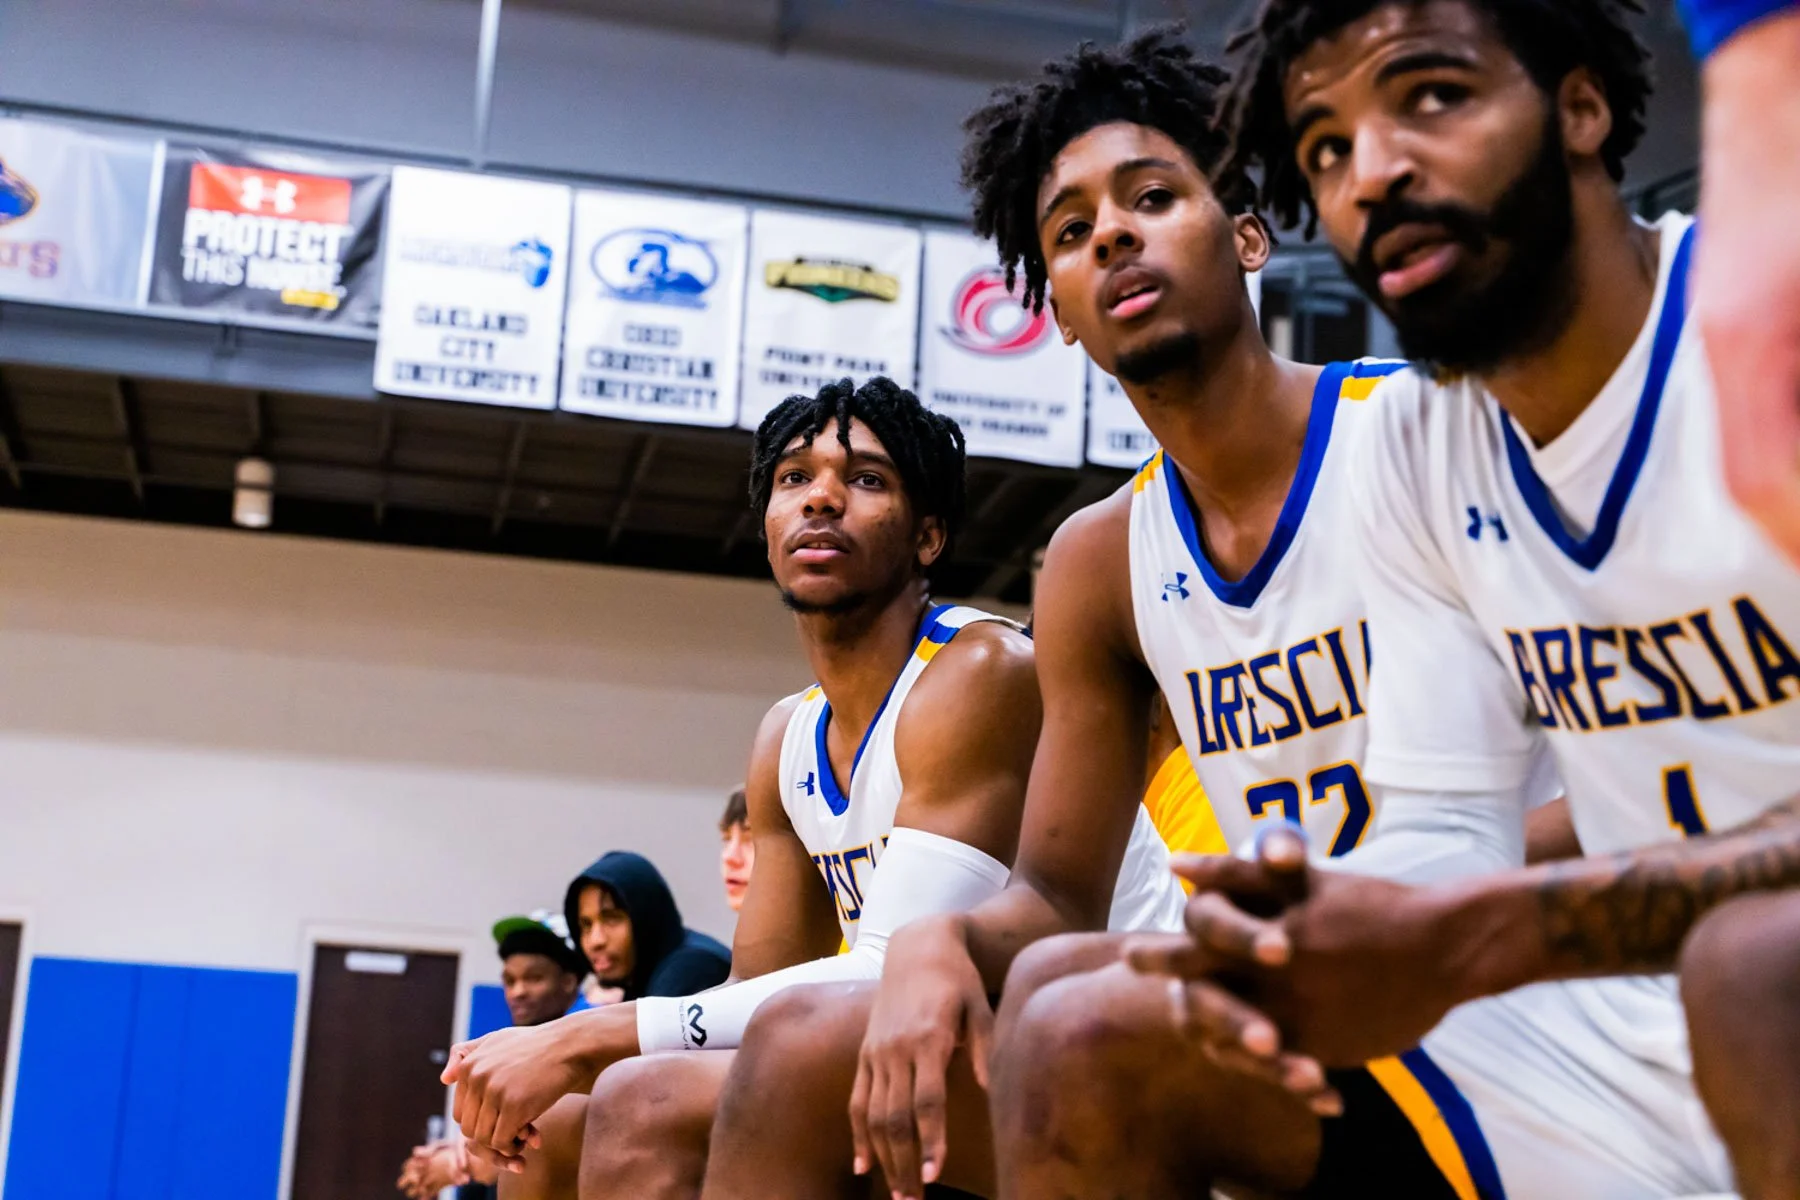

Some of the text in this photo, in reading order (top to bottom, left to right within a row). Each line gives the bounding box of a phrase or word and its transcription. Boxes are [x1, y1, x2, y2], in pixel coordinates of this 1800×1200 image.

[182, 207, 354, 263] PROTECT
[180, 248, 245, 286] THIS
[414, 301, 529, 336] OAKLAND
[440, 334, 496, 365] CITY
[586, 346, 715, 380] CHRISTIAN
[764, 346, 887, 375] POINT PARK
[394, 360, 540, 396] UNIVERSITY
[578, 374, 721, 411] UNIVERSITY
[931, 389, 1039, 415] UNIVERSITY
[1503, 593, 1800, 734] BRESCIA
